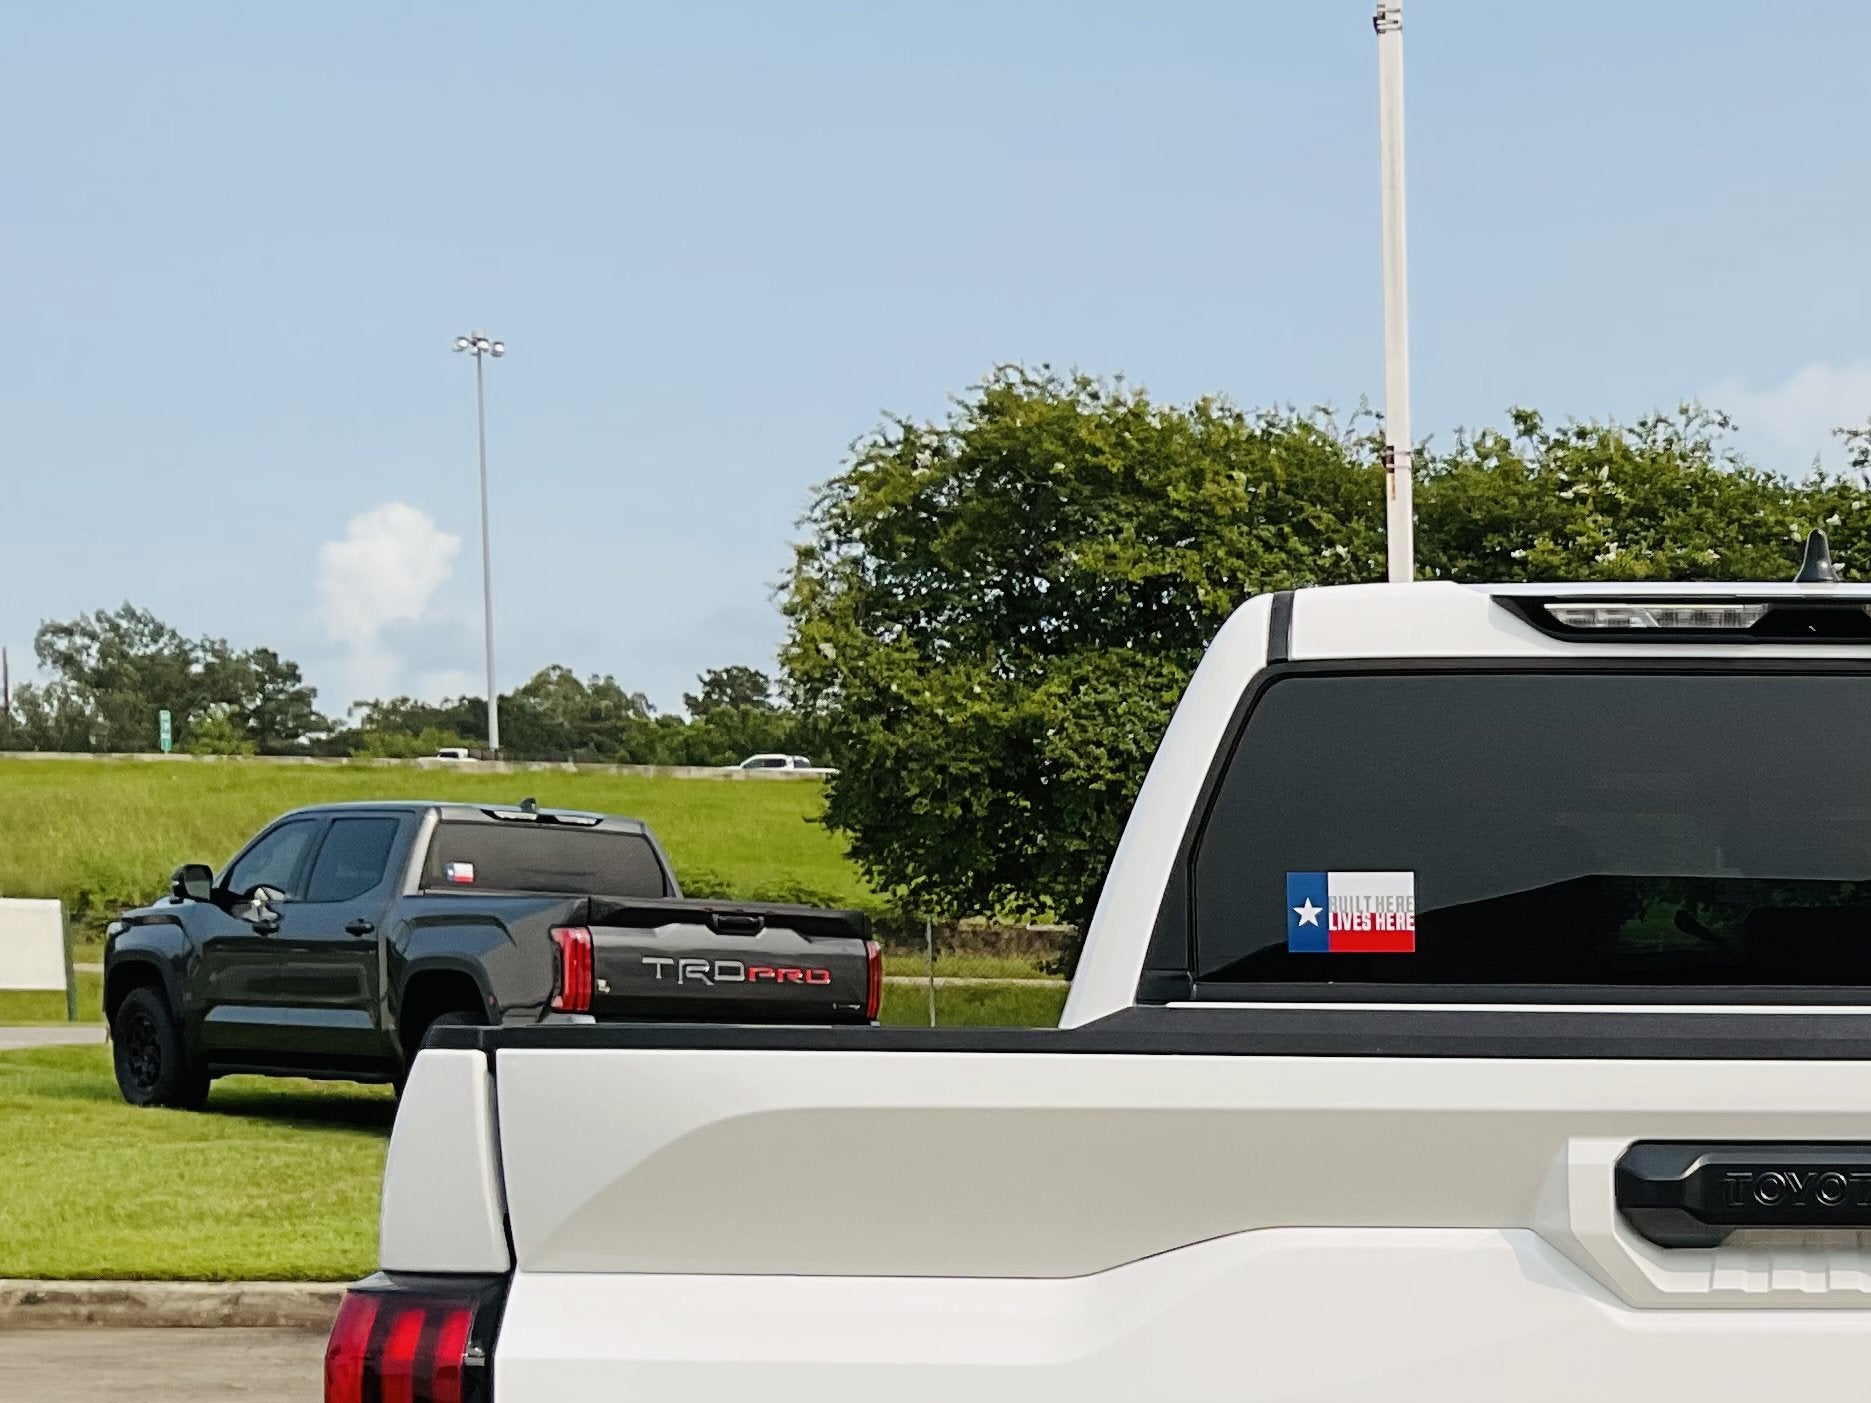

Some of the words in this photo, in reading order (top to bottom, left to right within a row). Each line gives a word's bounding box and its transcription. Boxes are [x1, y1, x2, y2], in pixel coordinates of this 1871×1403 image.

[1328, 895, 1371, 913] BUILT
[1375, 895, 1414, 913] HERE
[1328, 912, 1372, 931] LIVES
[1375, 912, 1415, 931] HERE
[641, 956, 746, 986] TRD
[747, 966, 832, 985] PRO
